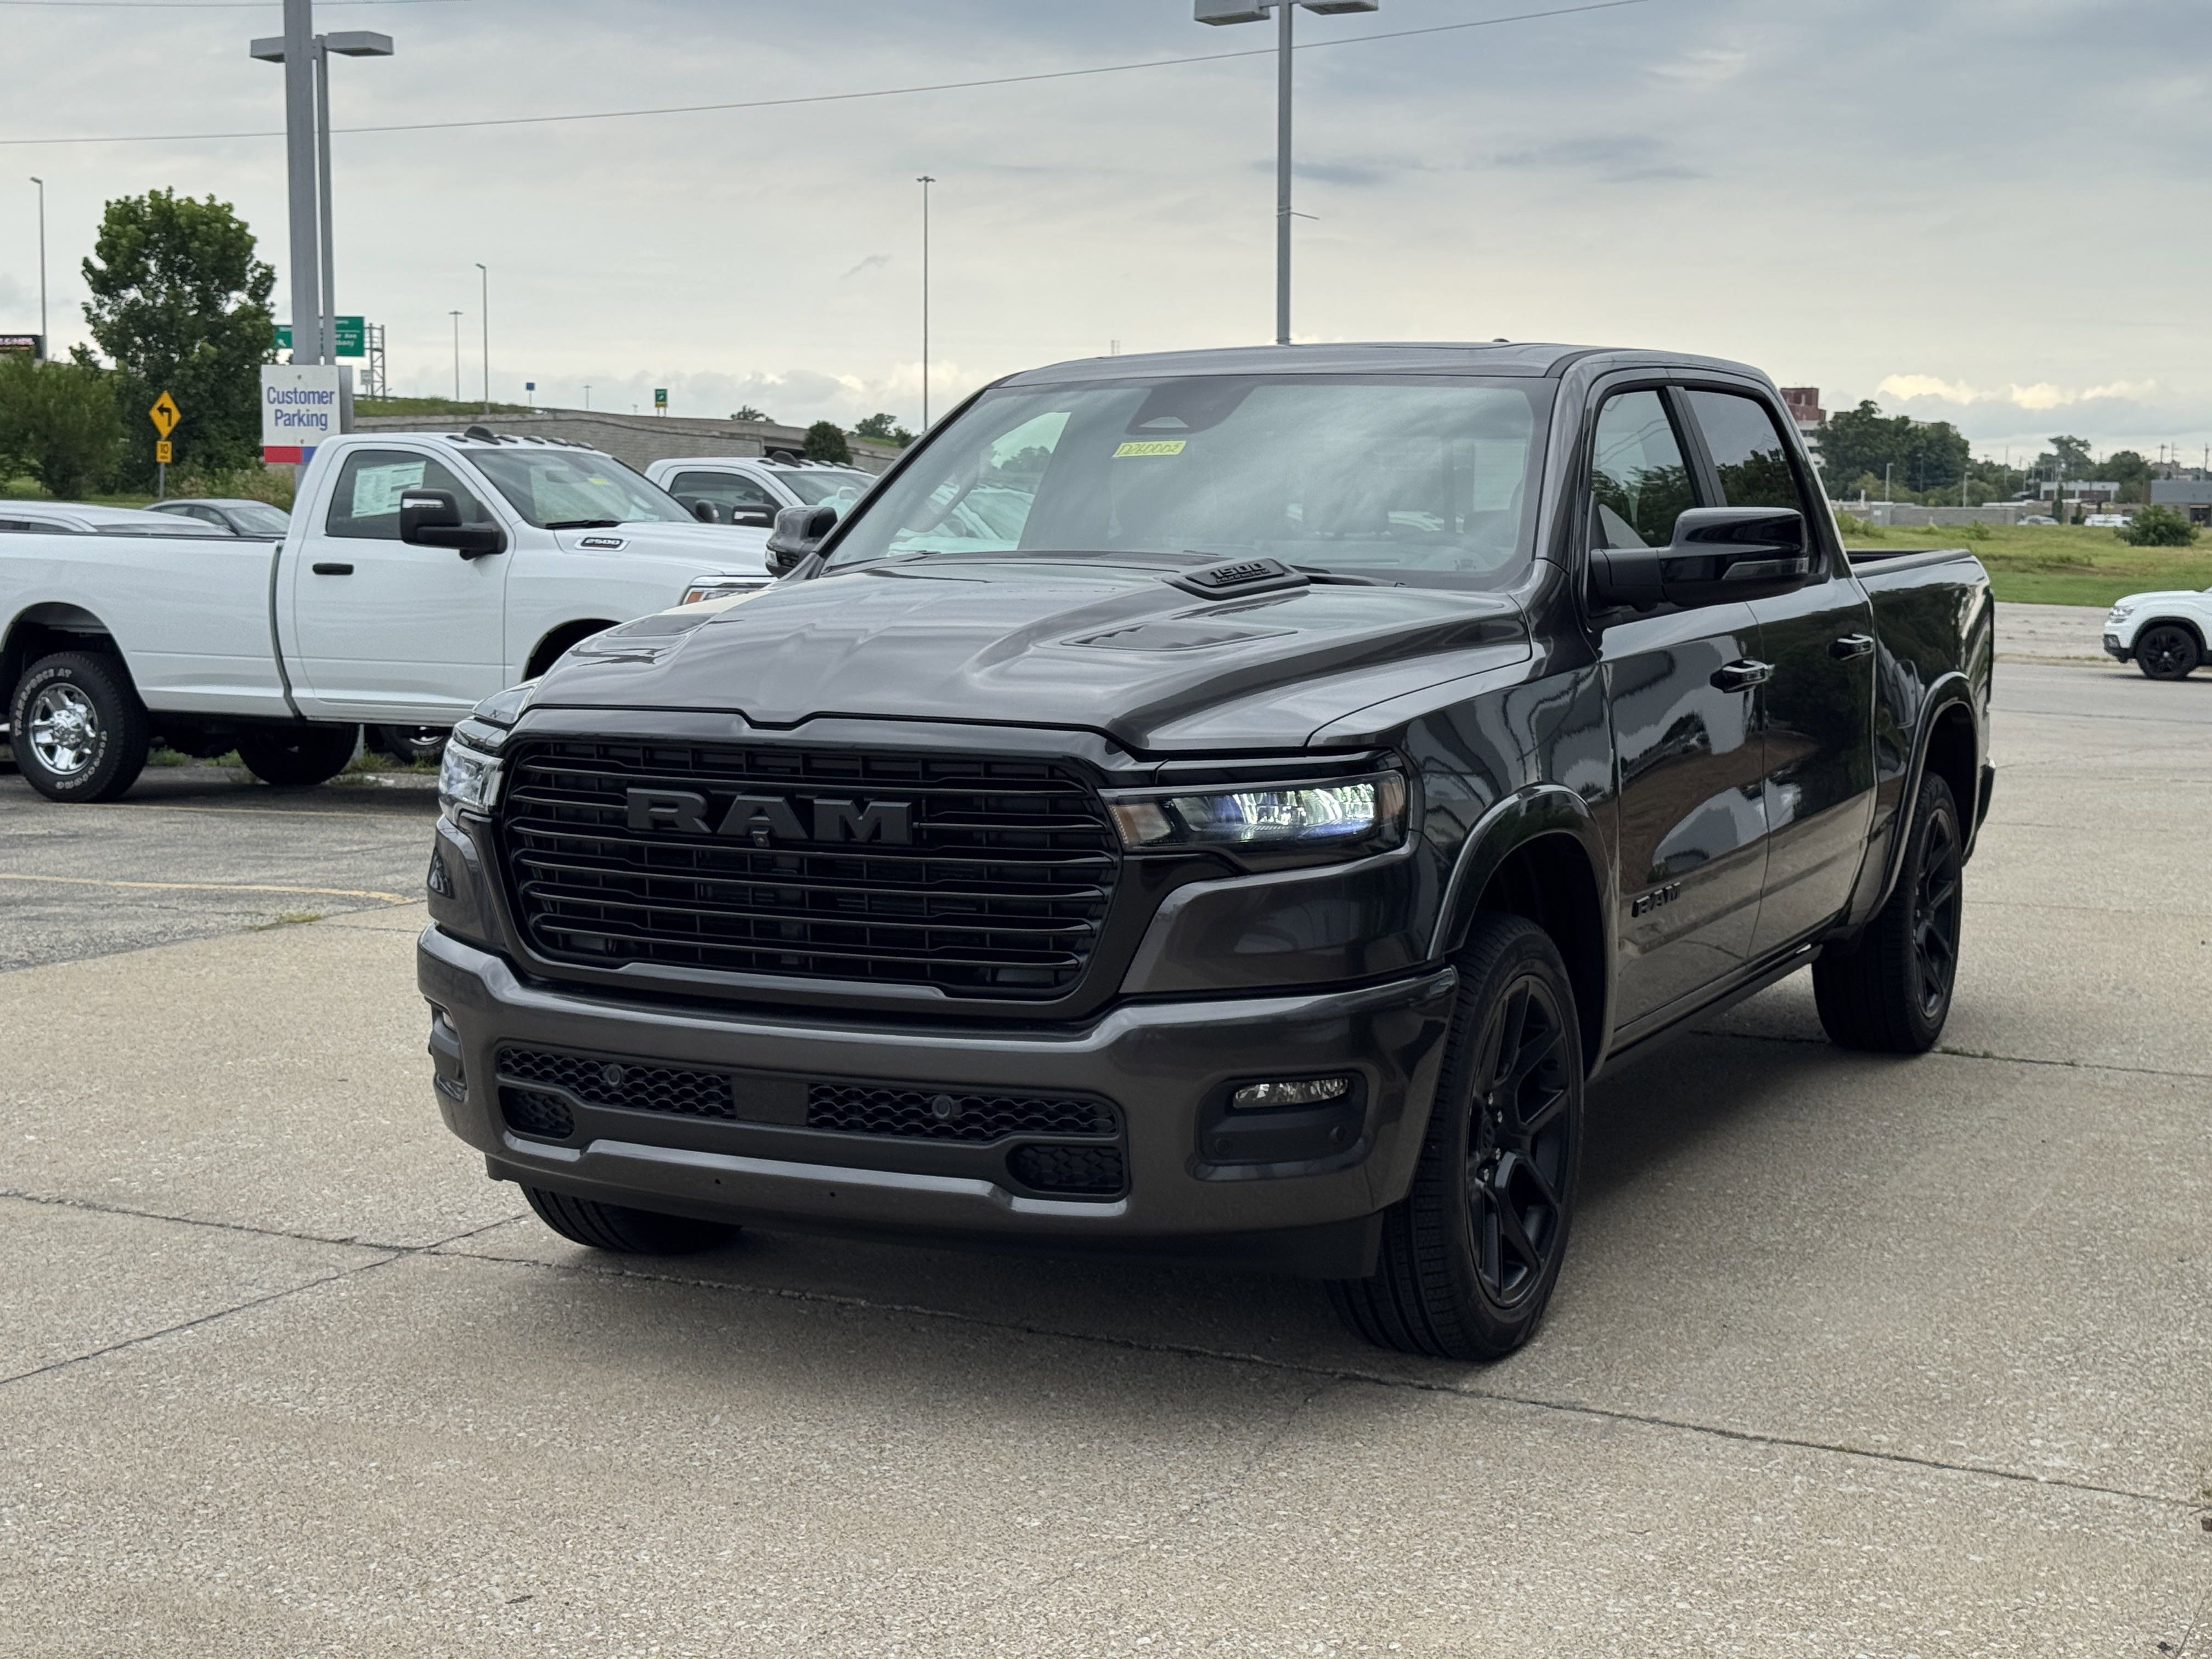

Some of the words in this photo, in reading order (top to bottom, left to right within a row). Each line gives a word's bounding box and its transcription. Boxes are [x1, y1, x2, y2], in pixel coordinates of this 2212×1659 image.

[267, 386, 335, 404] Customer
[274, 409, 328, 431] Parking
[1210, 563, 1264, 578] 1500
[57, 668, 72, 678] AT
[627, 787, 913, 846] RAM
[1632, 882, 1681, 918] RAM
